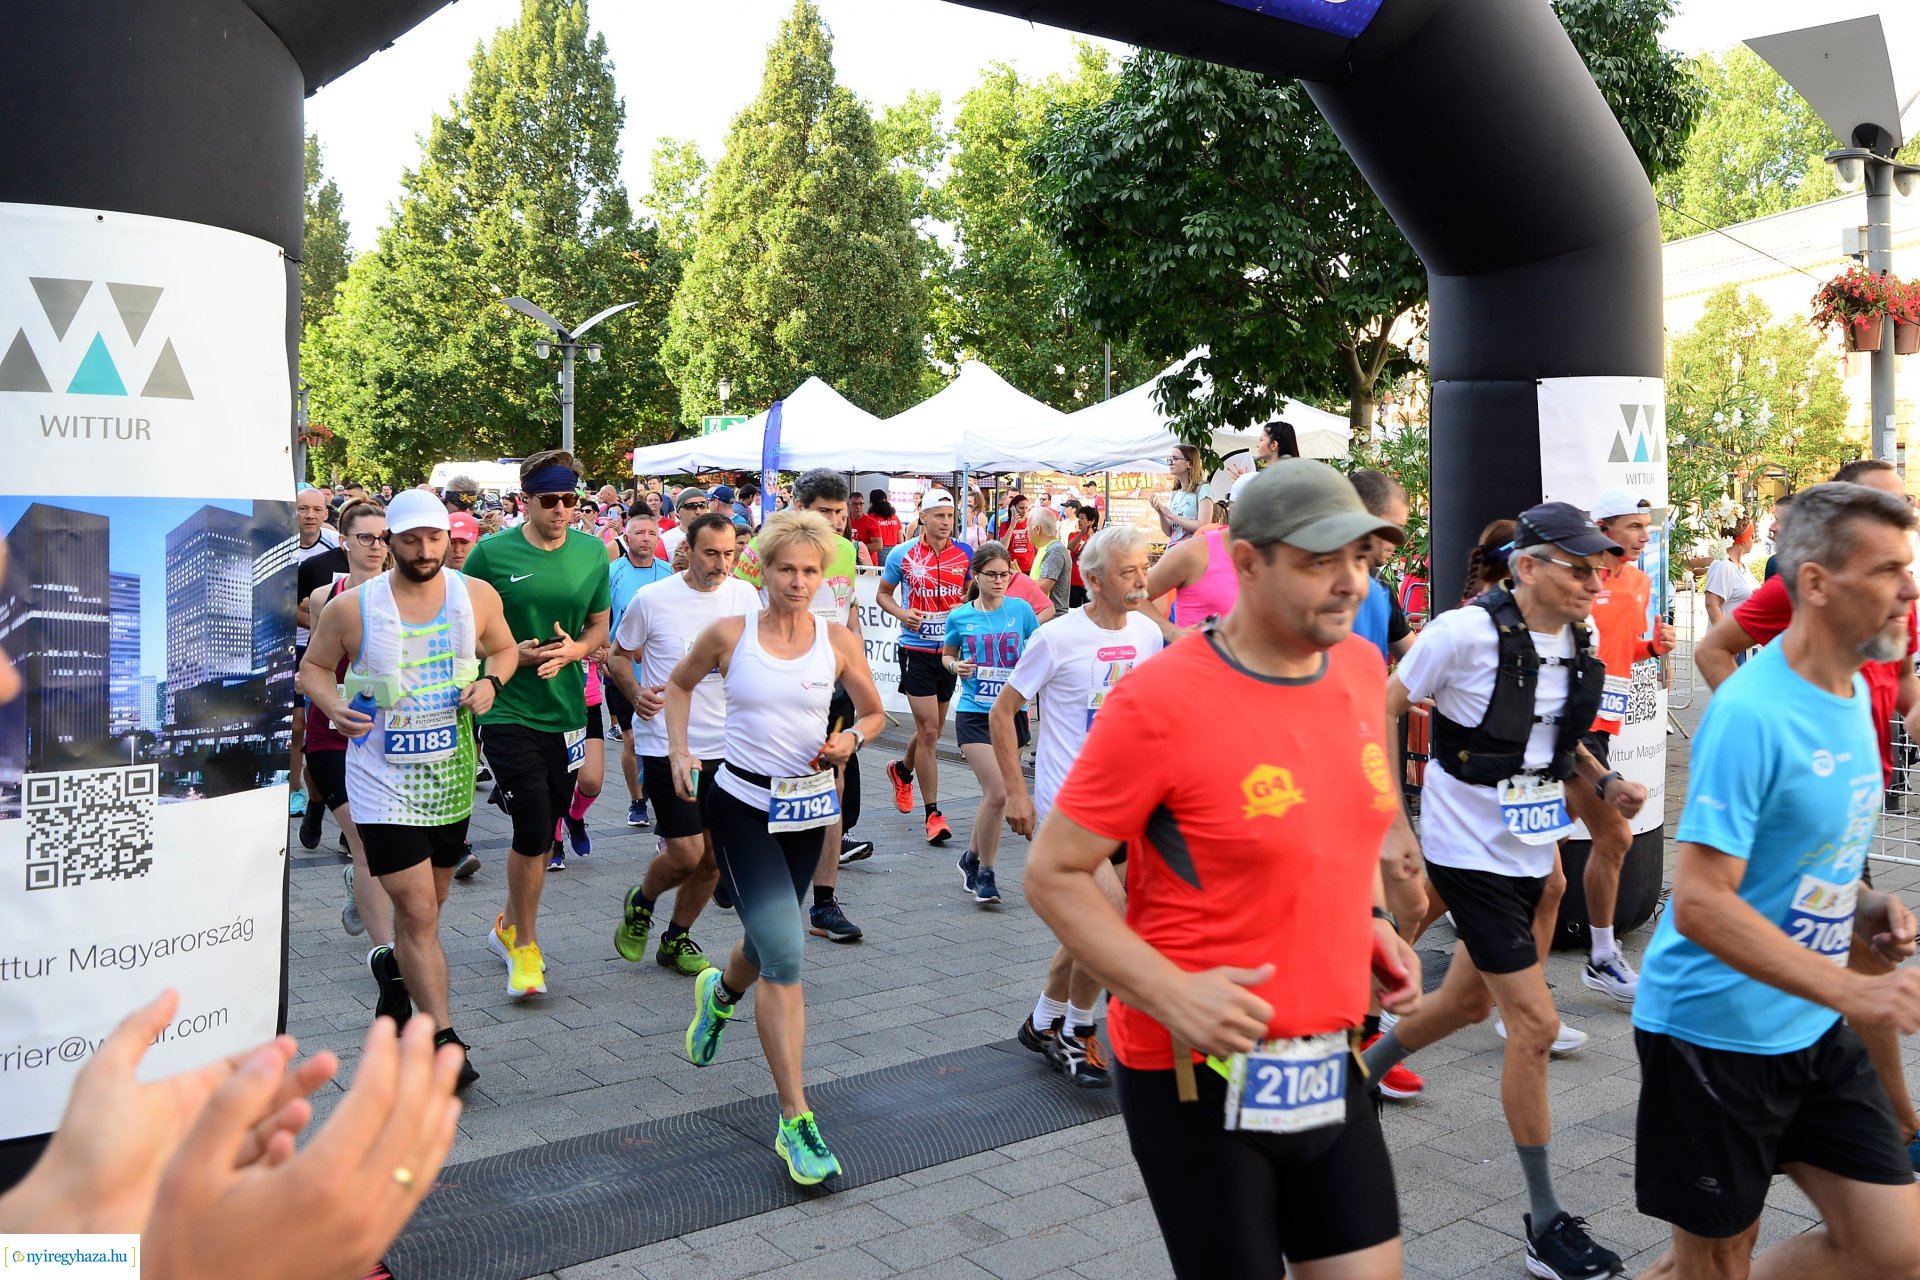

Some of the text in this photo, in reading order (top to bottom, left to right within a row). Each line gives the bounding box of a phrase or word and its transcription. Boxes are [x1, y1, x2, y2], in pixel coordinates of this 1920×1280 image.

[40, 415, 151, 440] WITTUR
[1625, 473, 1655, 485] WITTUR
[913, 586, 964, 597] ViniBike
[858, 605, 898, 628] REG
[922, 624, 945, 635] 2105
[979, 682, 1001, 695] 210
[391, 729, 452, 752] 21183
[775, 795, 835, 819] 21192
[1504, 803, 1560, 832] 21067
[69, 915, 254, 973] Magyarország
